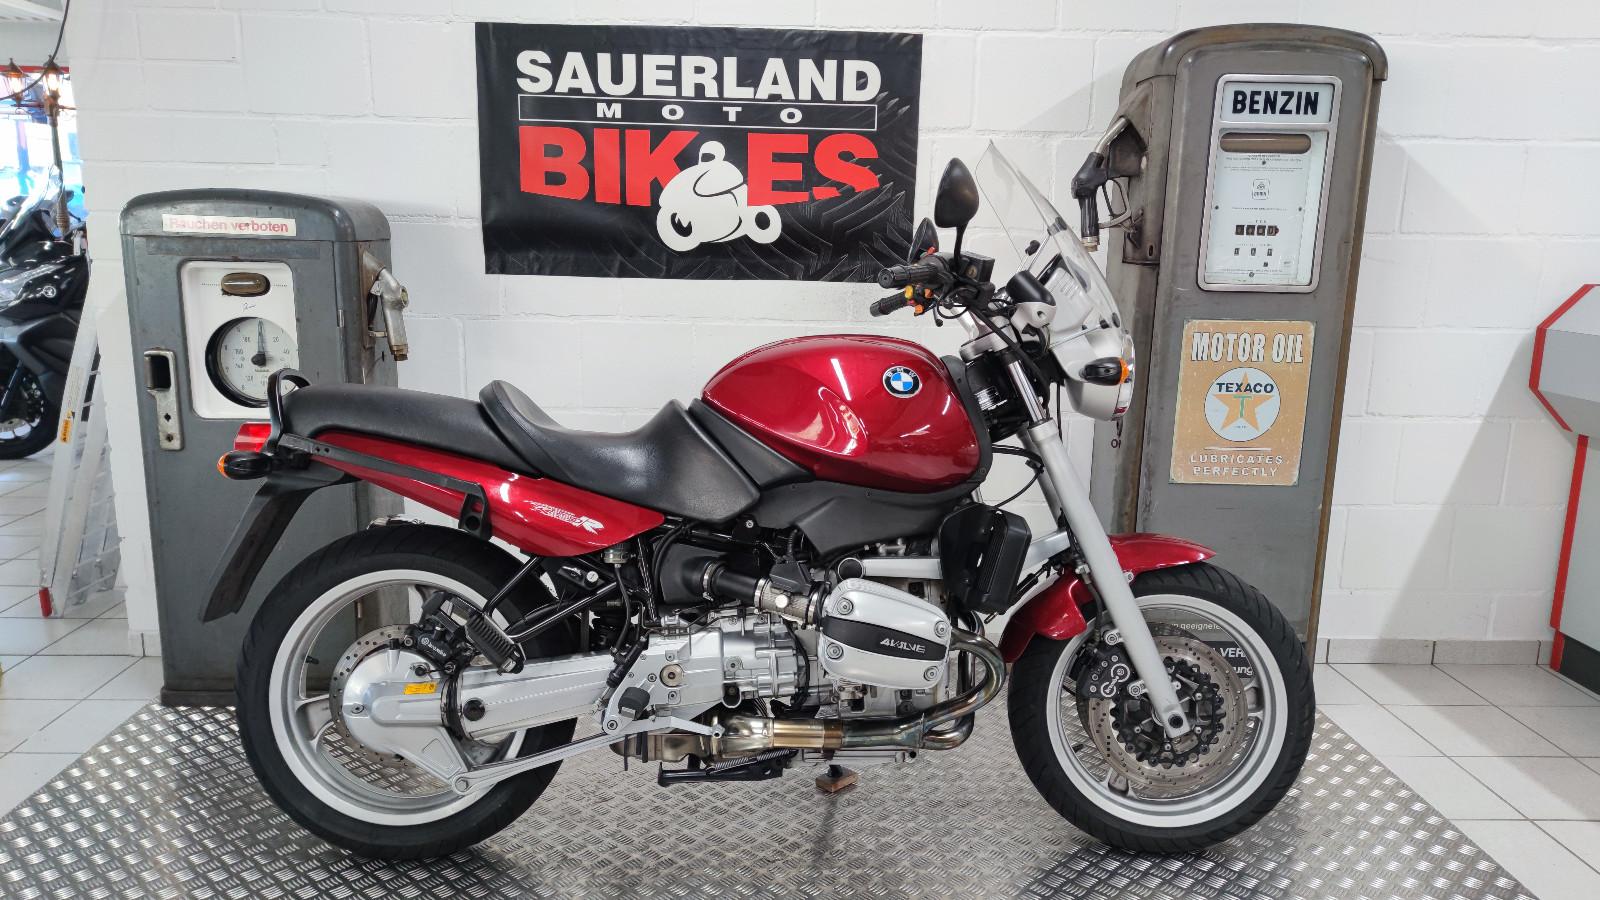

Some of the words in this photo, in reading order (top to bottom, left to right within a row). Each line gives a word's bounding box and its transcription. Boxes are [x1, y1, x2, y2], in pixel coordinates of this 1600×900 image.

[516, 50, 882, 102] SAUERLAND
[1232, 90, 1319, 115] BENZIN
[169, 217, 227, 230] Rauchen
[231, 220, 289, 233] verboten
[1190, 331, 1267, 363] MOTOR
[1272, 333, 1304, 364] OIL
[1216, 382, 1275, 394] TEXACO
[1189, 453, 1284, 465] LUBRICATES
[1192, 466, 1278, 477] PERFECTLY
